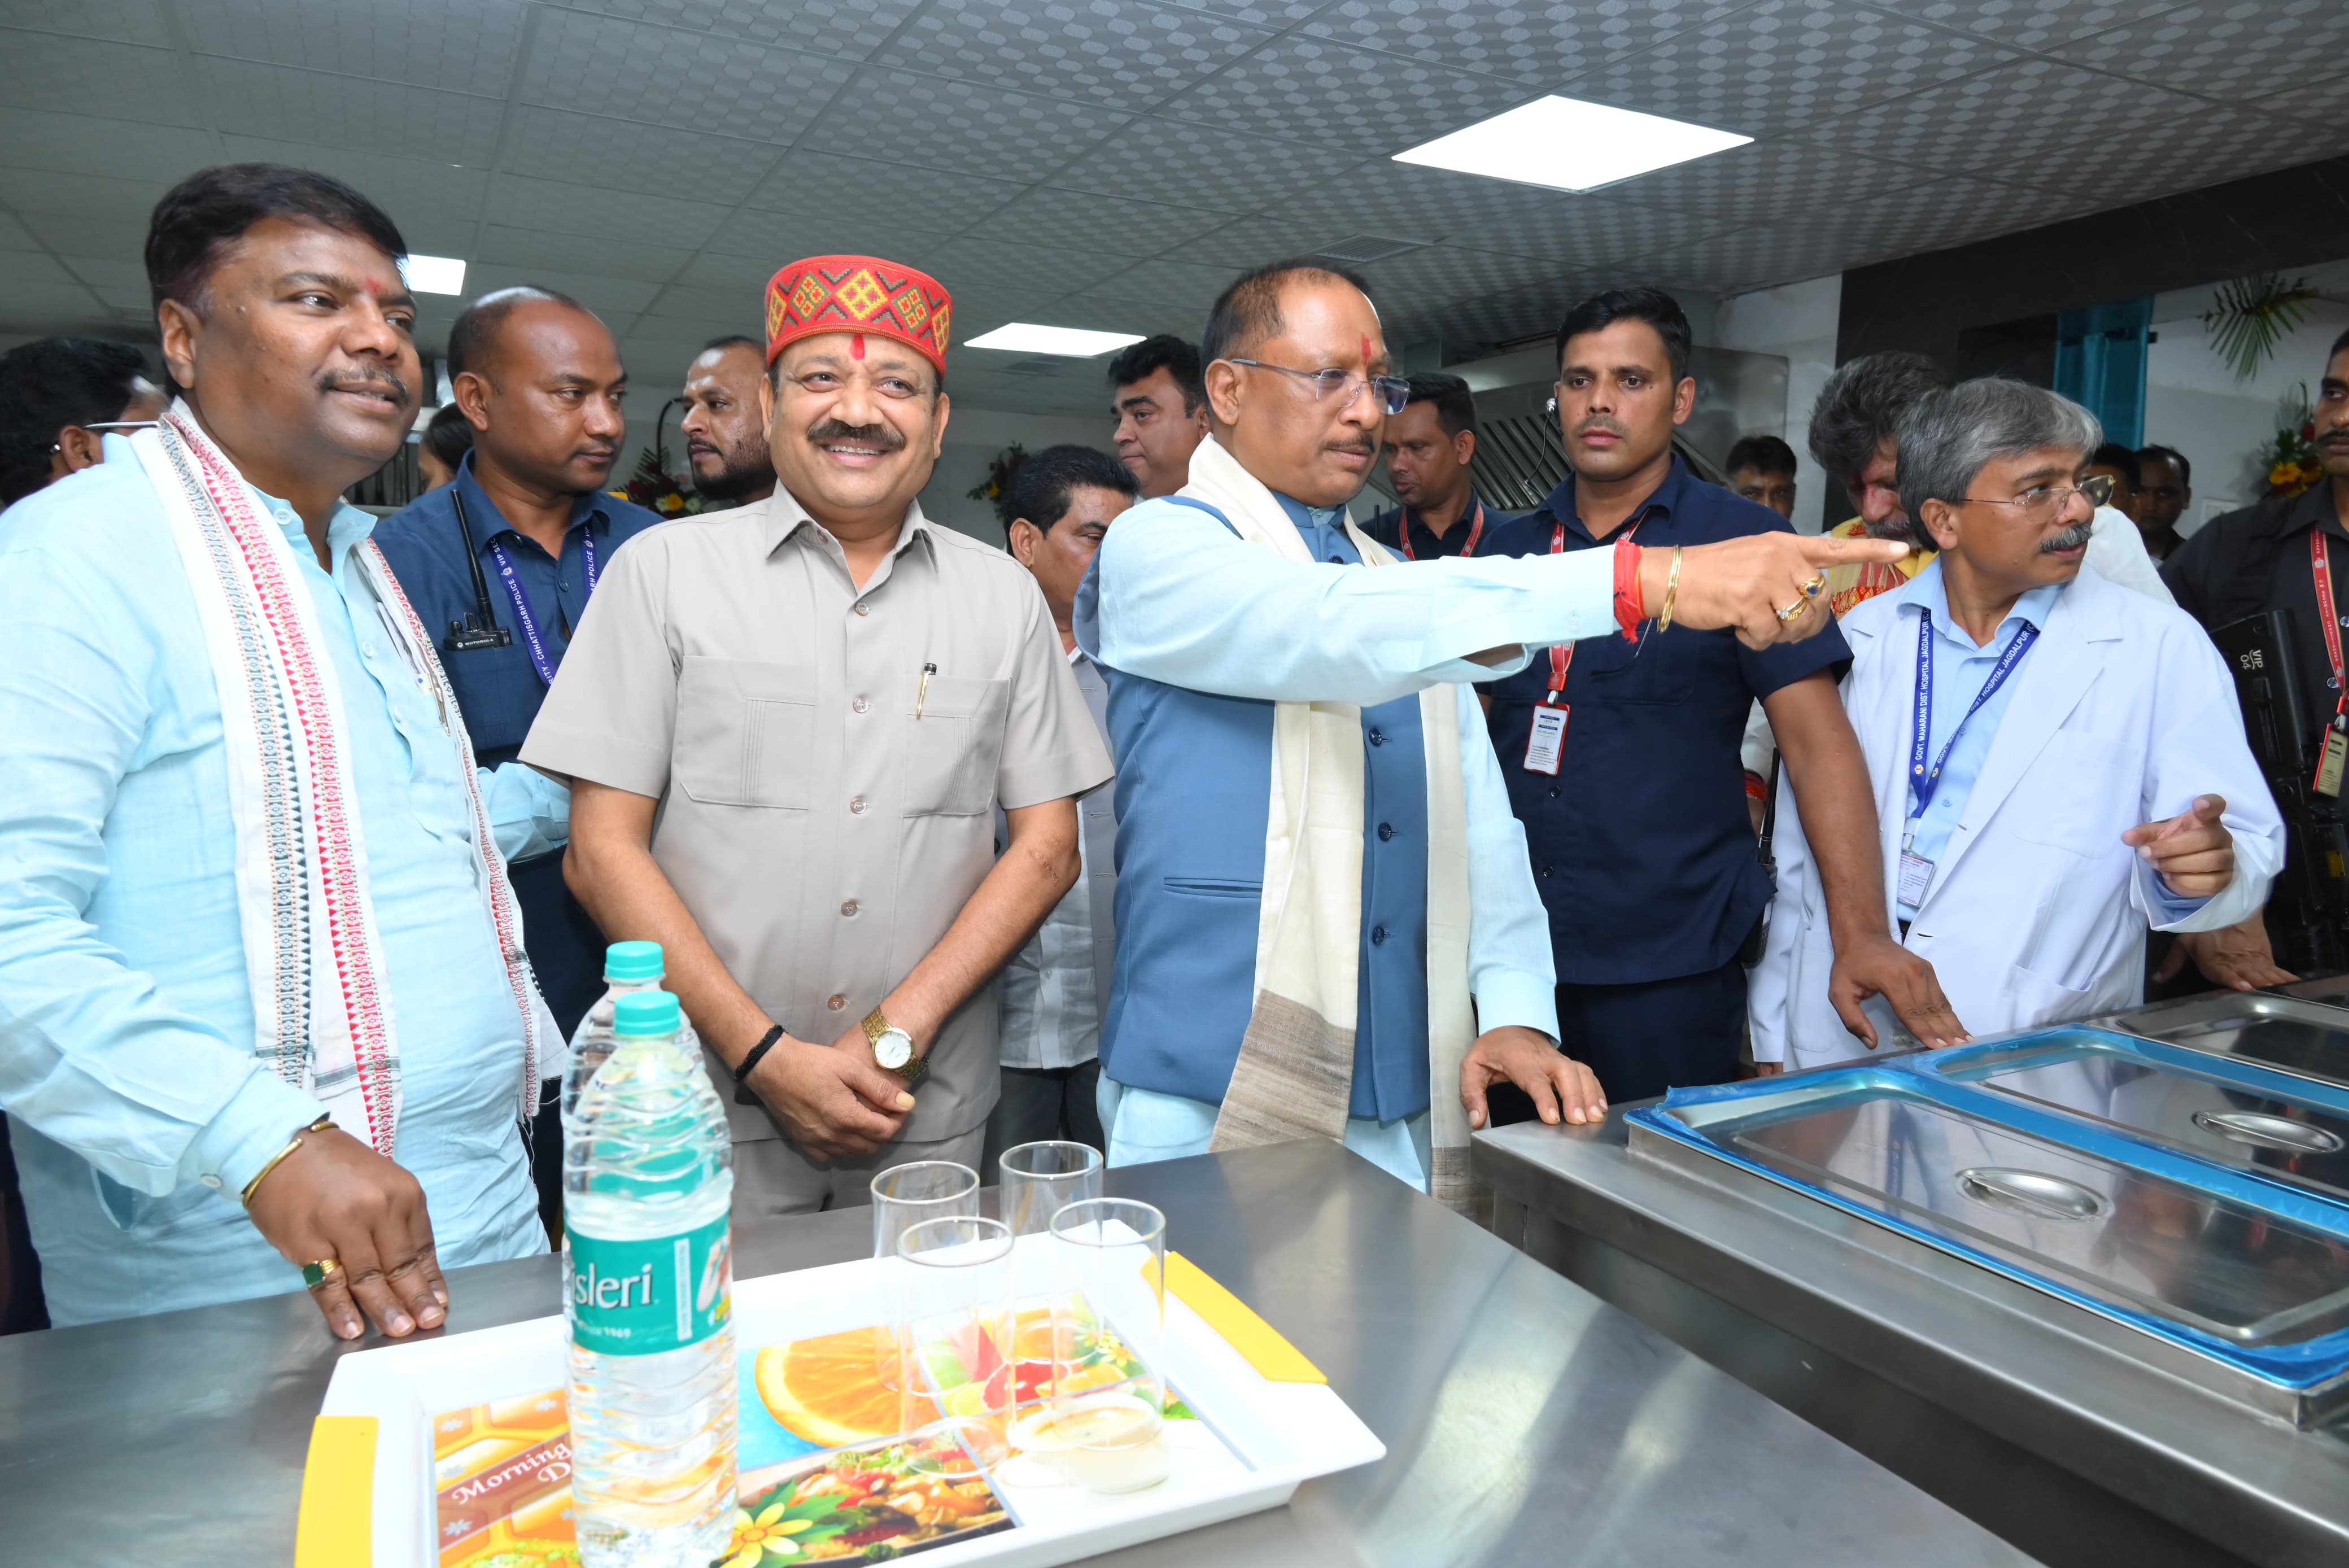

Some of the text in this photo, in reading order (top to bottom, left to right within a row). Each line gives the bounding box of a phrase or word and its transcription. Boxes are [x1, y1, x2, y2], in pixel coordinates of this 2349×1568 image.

[490, 538, 500, 553] SEC
[496, 554, 506, 566] VIP
[508, 578, 523, 605] POLICE
[518, 605, 544, 660] CHHATTISGARH
[1981, 668, 2005, 697] HOSPITAL
[2002, 631, 2030, 669] JAGDALPUR
[2240, 654, 2251, 670] 04
[2252, 649, 2263, 668] VIP
[1920, 658, 1929, 689] HOSPITAL
[1918, 707, 1927, 741] MAHARANI
[1915, 741, 1924, 760] GOVT.
[452, 1442, 571, 1504] Morning
[537, 1461, 571, 1482] D
